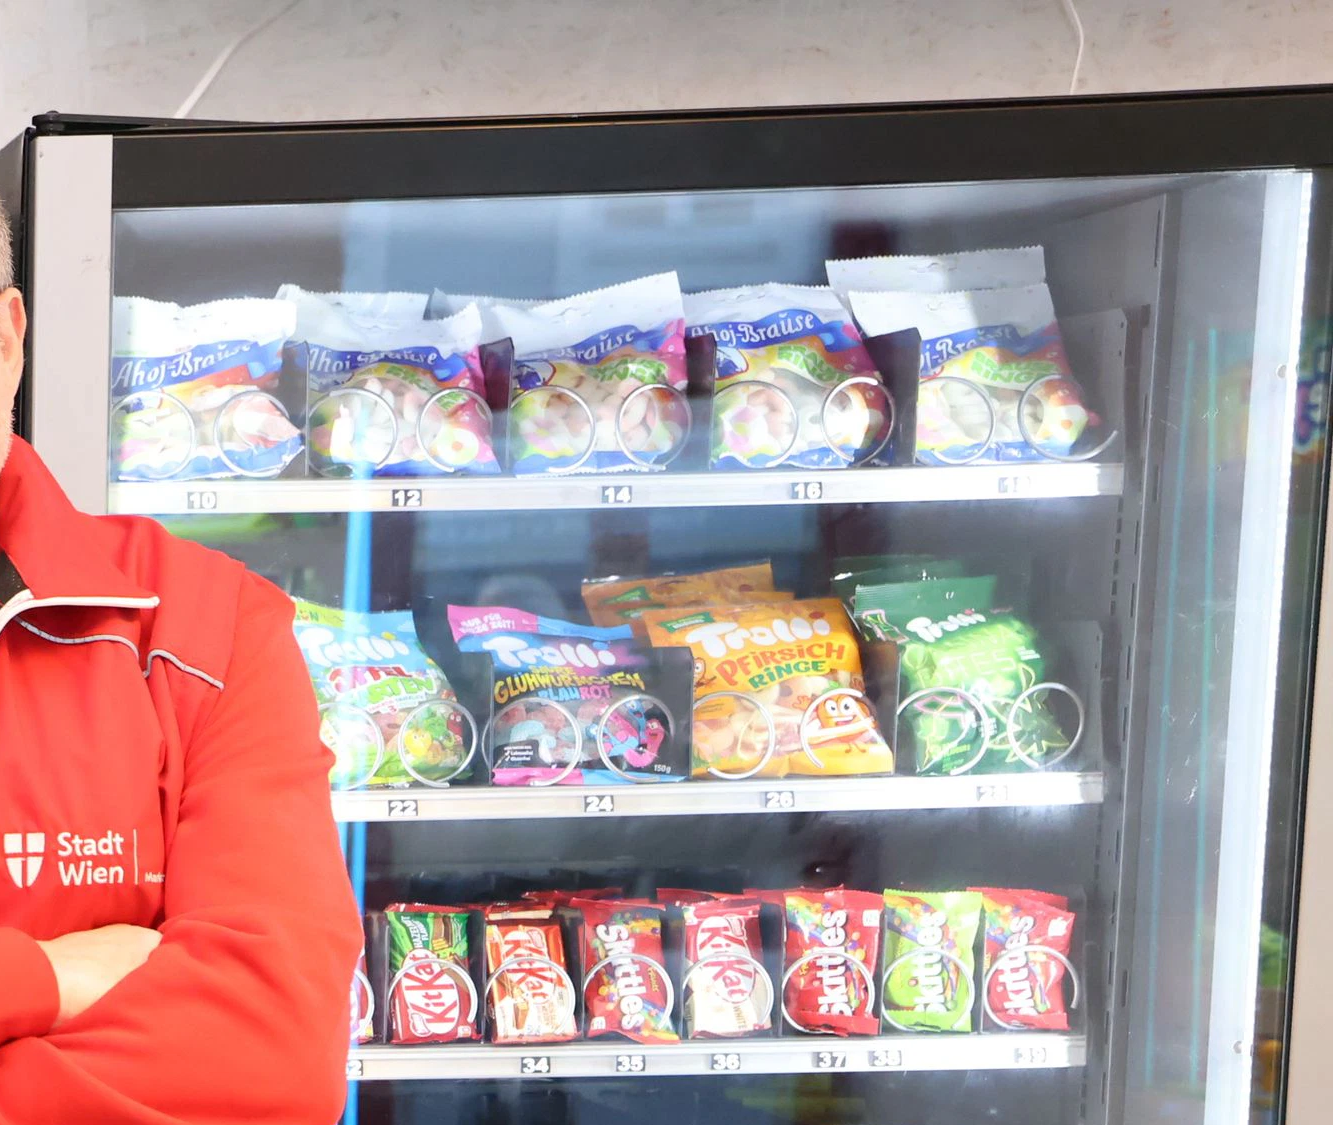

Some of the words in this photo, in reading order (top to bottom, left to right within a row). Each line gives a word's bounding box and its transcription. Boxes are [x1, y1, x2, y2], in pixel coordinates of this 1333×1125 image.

[395, 490, 421, 506] 12
[603, 487, 631, 502] 14
[793, 483, 821, 498] 16
[189, 493, 215, 508] 10
[685, 611, 831, 658] Trolli
[481, 635, 616, 668] Trolli
[654, 764, 671, 773] 150g
[586, 797, 612, 812] 24
[766, 793, 794, 807] 26
[390, 802, 417, 815] 22
[57, 830, 124, 857] Stadt
[58, 860, 124, 886] Wien
[523, 1058, 549, 1073] 34
[618, 1056, 644, 1071] 35
[712, 1055, 739, 1069] 36
[819, 1053, 845, 1067] 37
